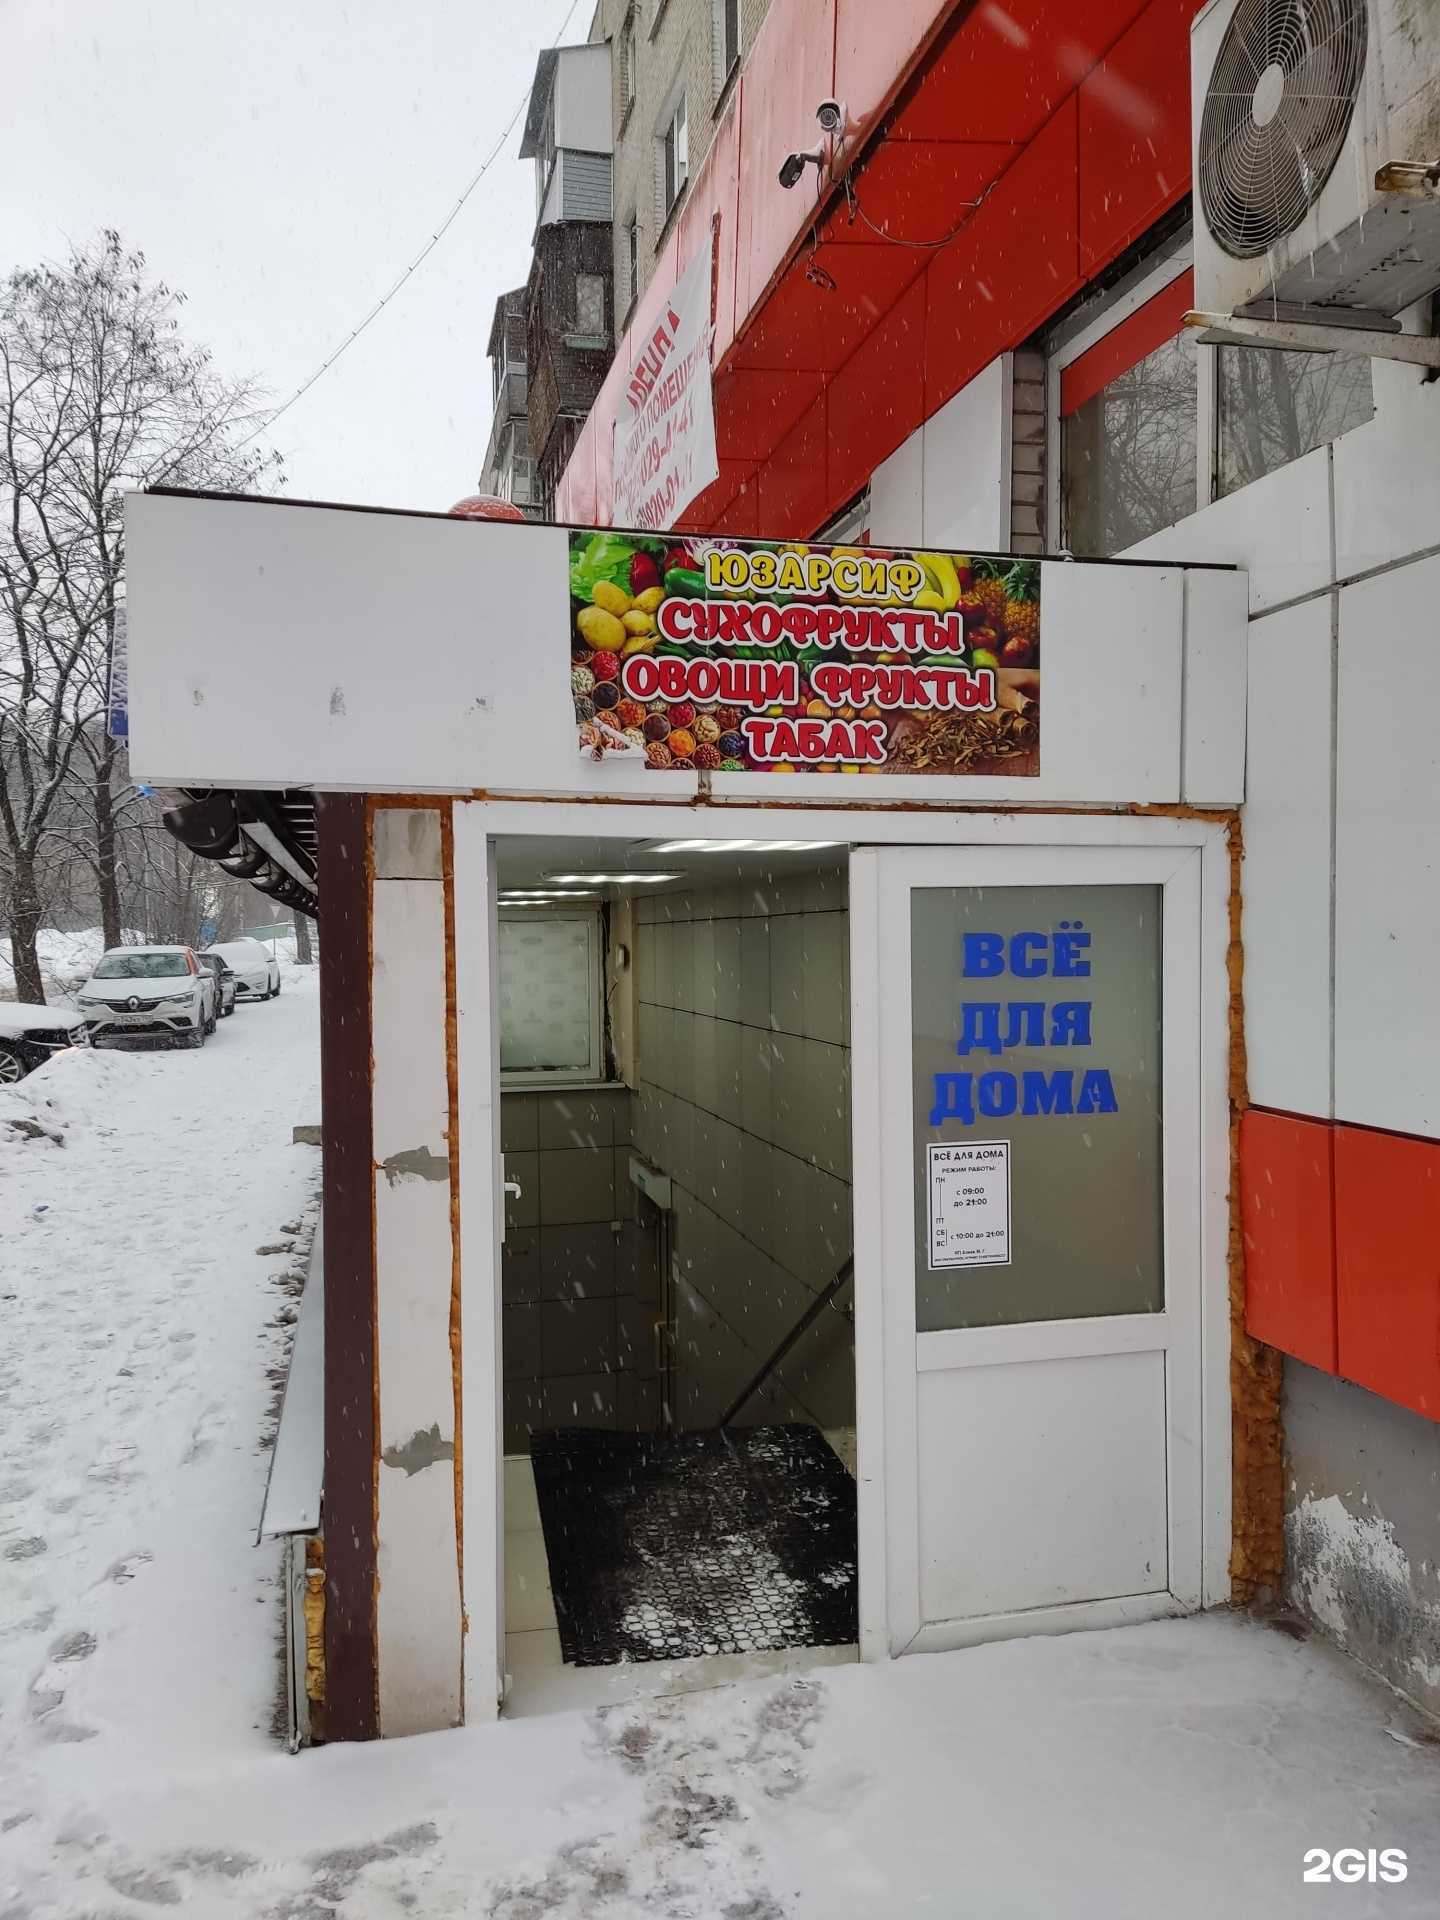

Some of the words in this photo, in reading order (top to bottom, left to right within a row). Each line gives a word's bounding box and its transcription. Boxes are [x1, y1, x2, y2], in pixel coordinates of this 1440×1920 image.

[708, 553, 922, 595] ЮЗАРСИФ
[662, 602, 960, 651] СУХОФРУКТЫ
[626, 659, 796, 707] ОВОЩИ
[815, 666, 991, 708] ФРУКТЫ
[745, 721, 885, 760] ТАБАК
[962, 921, 1091, 978] ВСЁ
[956, 1001, 1092, 1056] ДЛЯ
[929, 1069, 1119, 1127] ДОМА
[934, 1151, 951, 1161] ВСЁ
[954, 1152, 973, 1160] ДЛЯ
[976, 1150, 1004, 1160] ДОМА
[942, 1166, 966, 1174] РЕЖИМ
[962, 1187, 985, 1195] 09:00
[966, 1198, 987, 1206] 21:00
